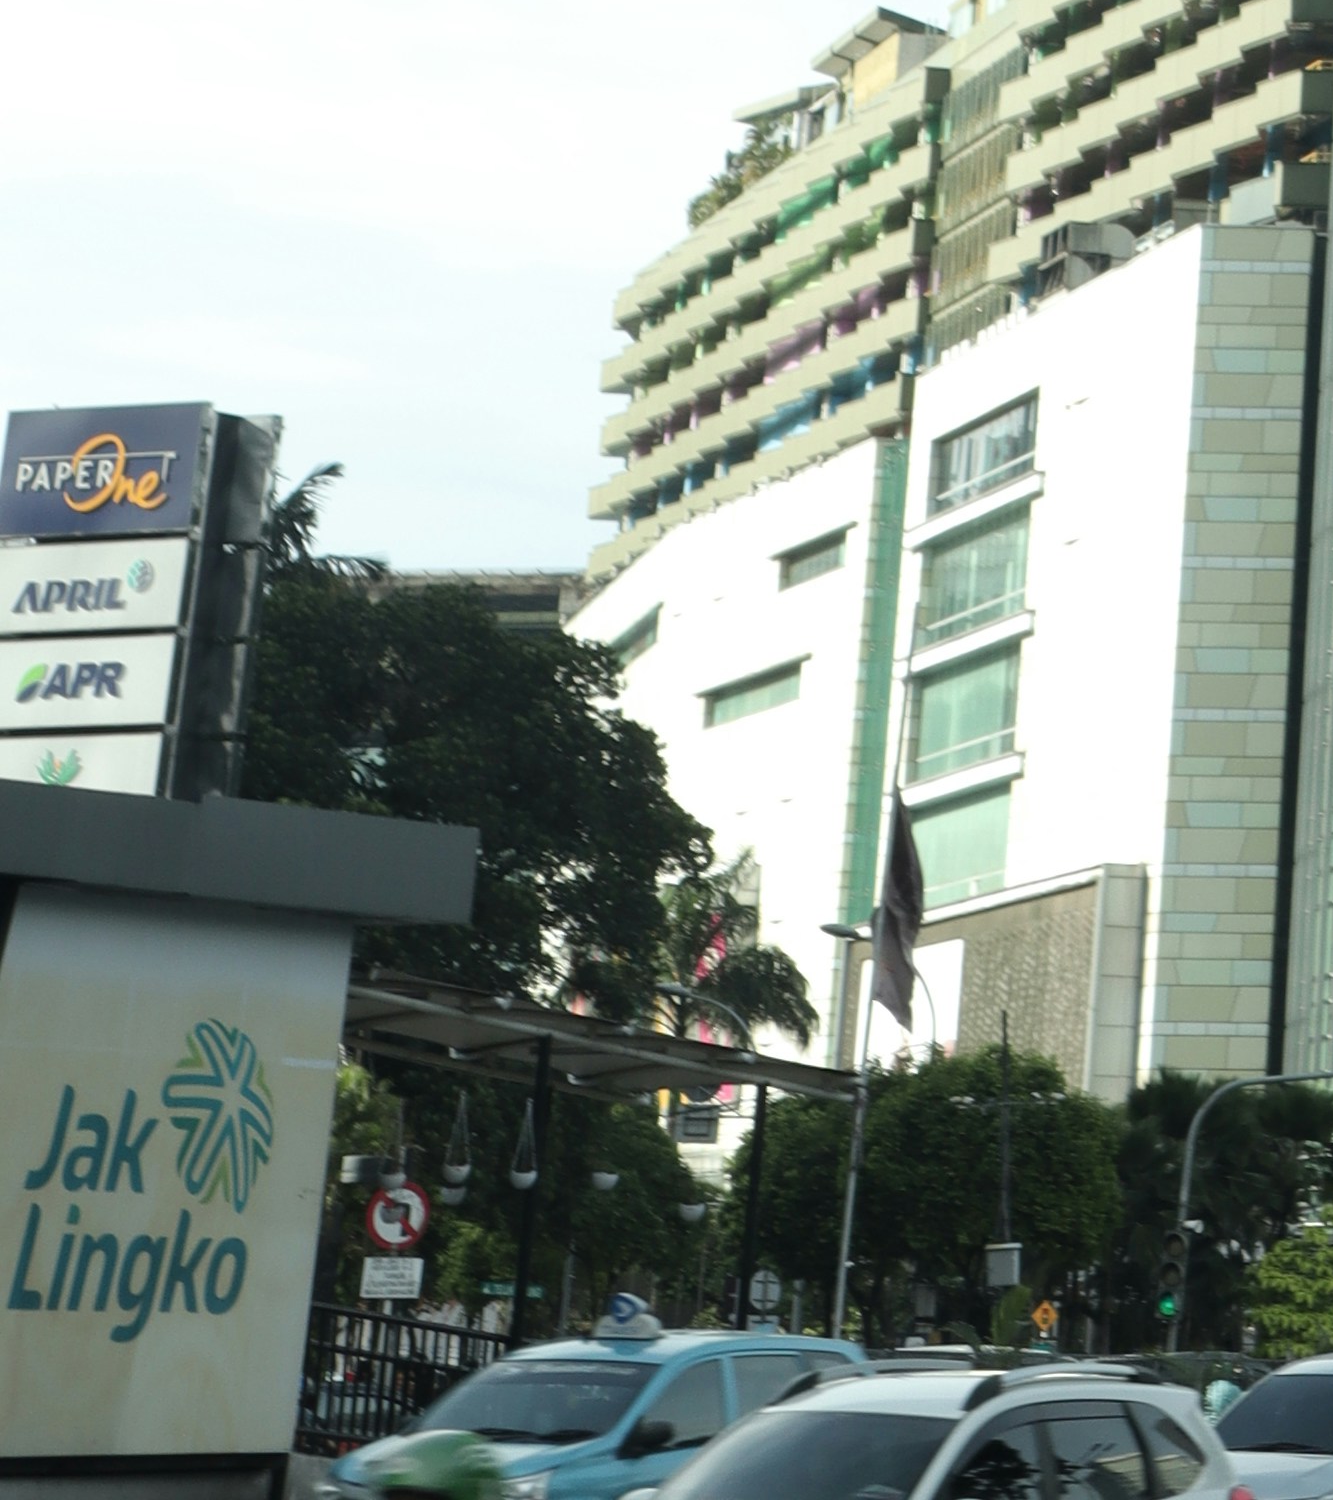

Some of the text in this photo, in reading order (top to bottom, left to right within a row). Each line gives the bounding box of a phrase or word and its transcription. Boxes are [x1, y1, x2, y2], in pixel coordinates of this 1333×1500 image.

[14, 458, 118, 493] PAPER
[11, 578, 127, 614] APRIL
[40, 662, 127, 699] APR
[24, 1084, 160, 1194] Jak
[7, 1202, 249, 1343] Lingko
